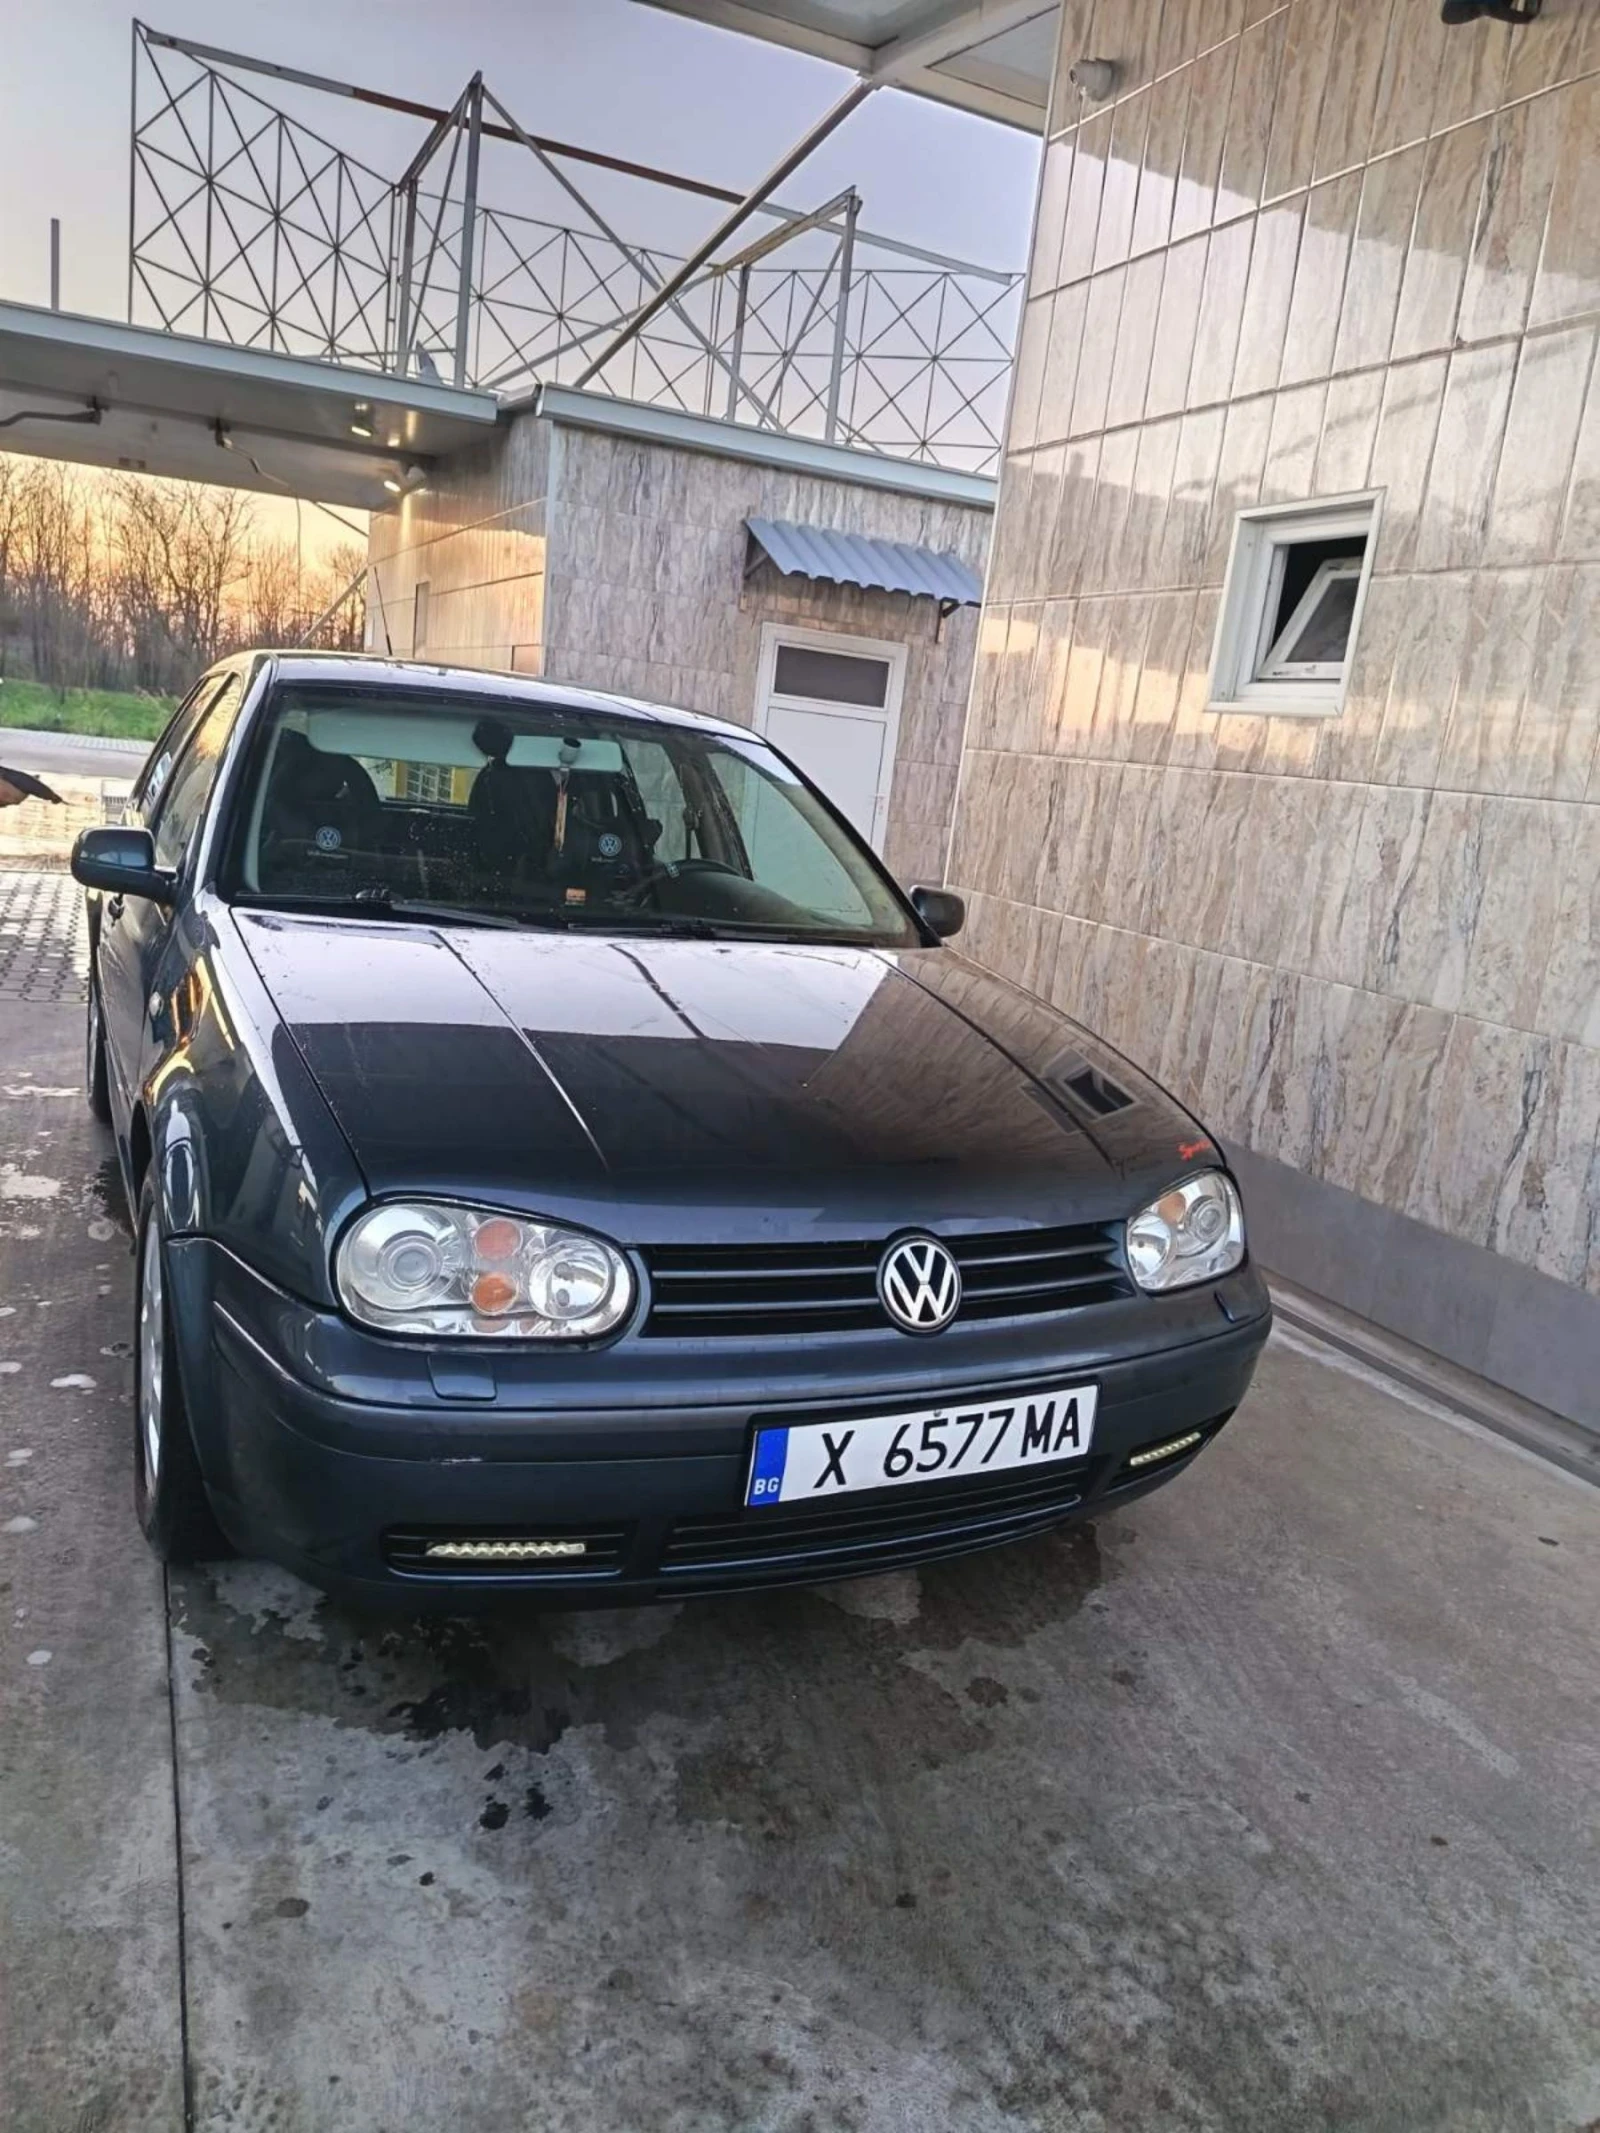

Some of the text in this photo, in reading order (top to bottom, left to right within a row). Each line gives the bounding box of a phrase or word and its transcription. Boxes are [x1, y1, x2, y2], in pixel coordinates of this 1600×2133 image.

[883, 1241, 960, 1328] VW
[754, 1477, 780, 1495] BG
[813, 1398, 1080, 1489] X 6577 MA
